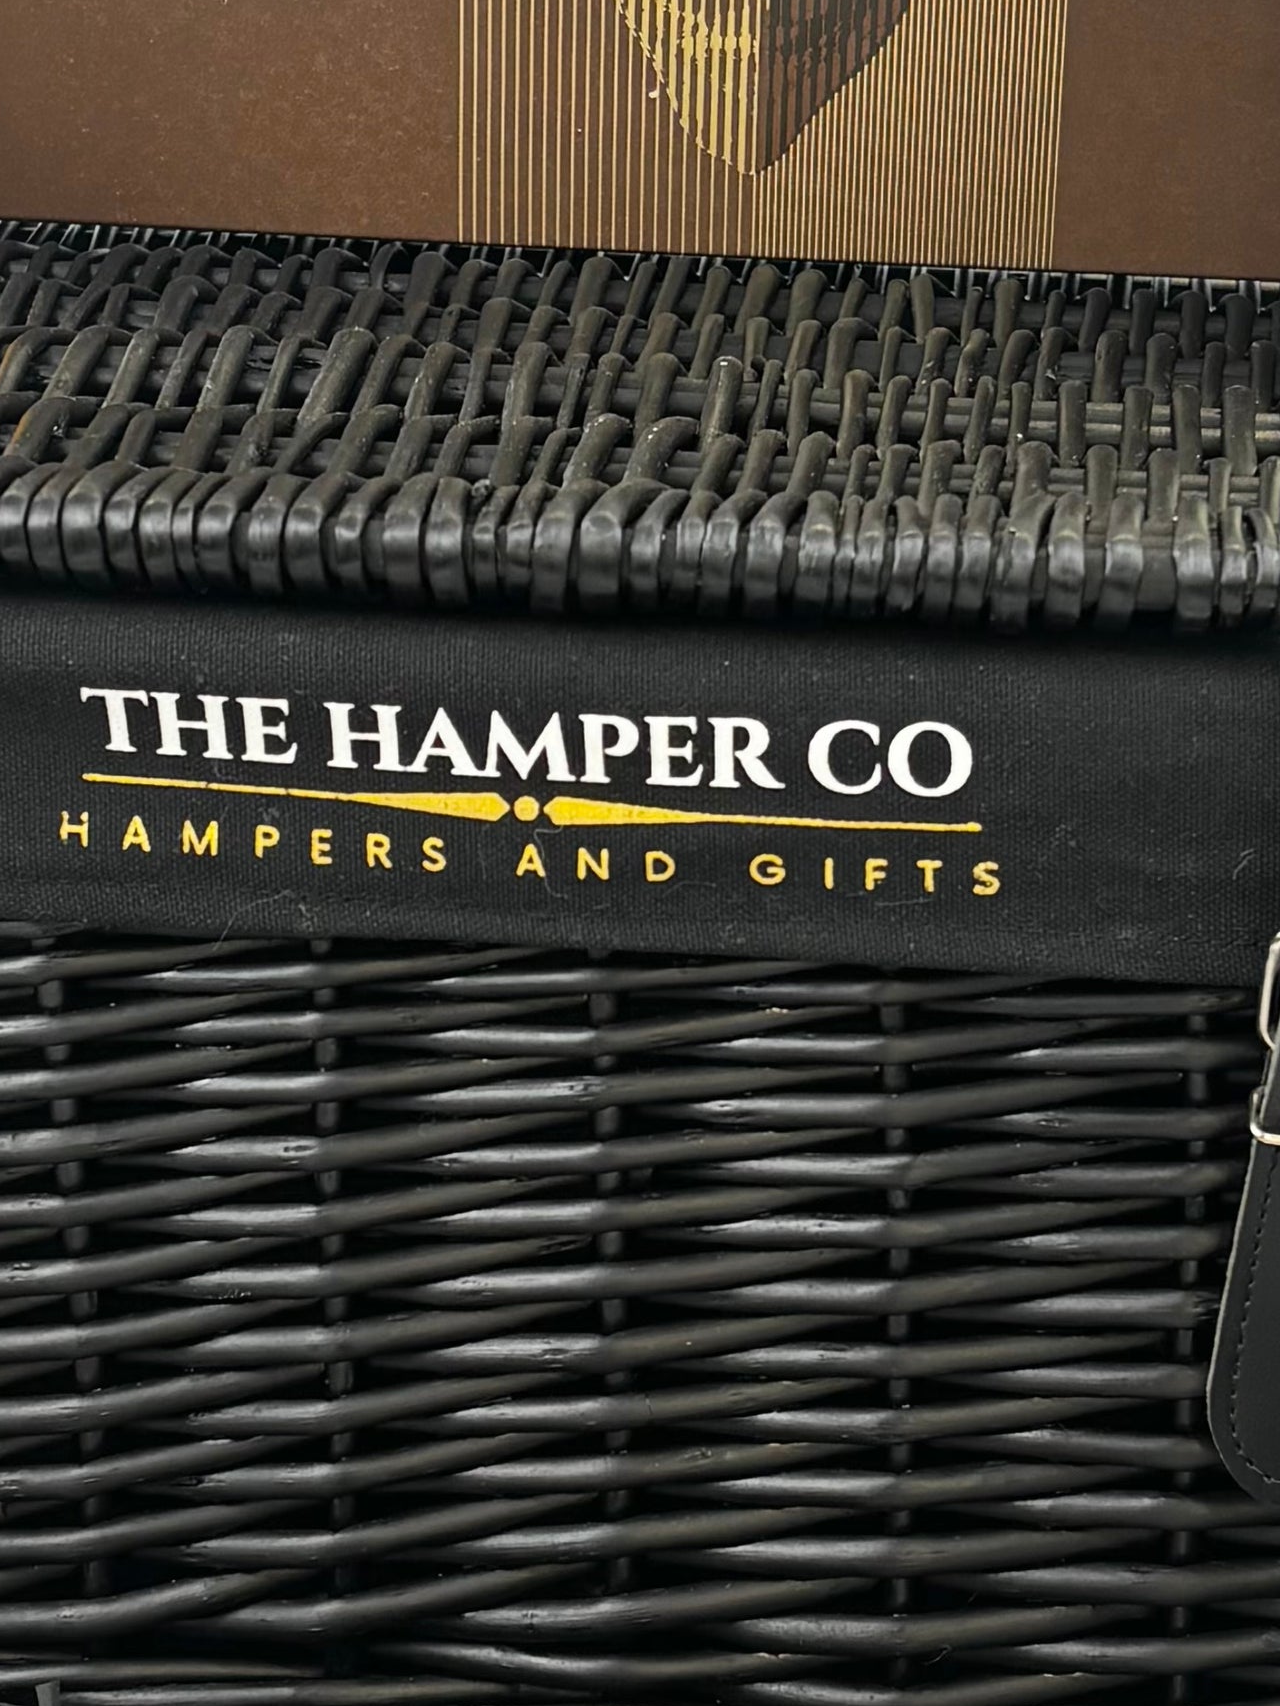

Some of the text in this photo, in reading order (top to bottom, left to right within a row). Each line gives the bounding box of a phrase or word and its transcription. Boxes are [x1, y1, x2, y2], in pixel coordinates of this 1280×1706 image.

[80, 686, 974, 798] THE HAMPER CO
[59, 810, 1002, 896] HAMPERS AND GIFTS
